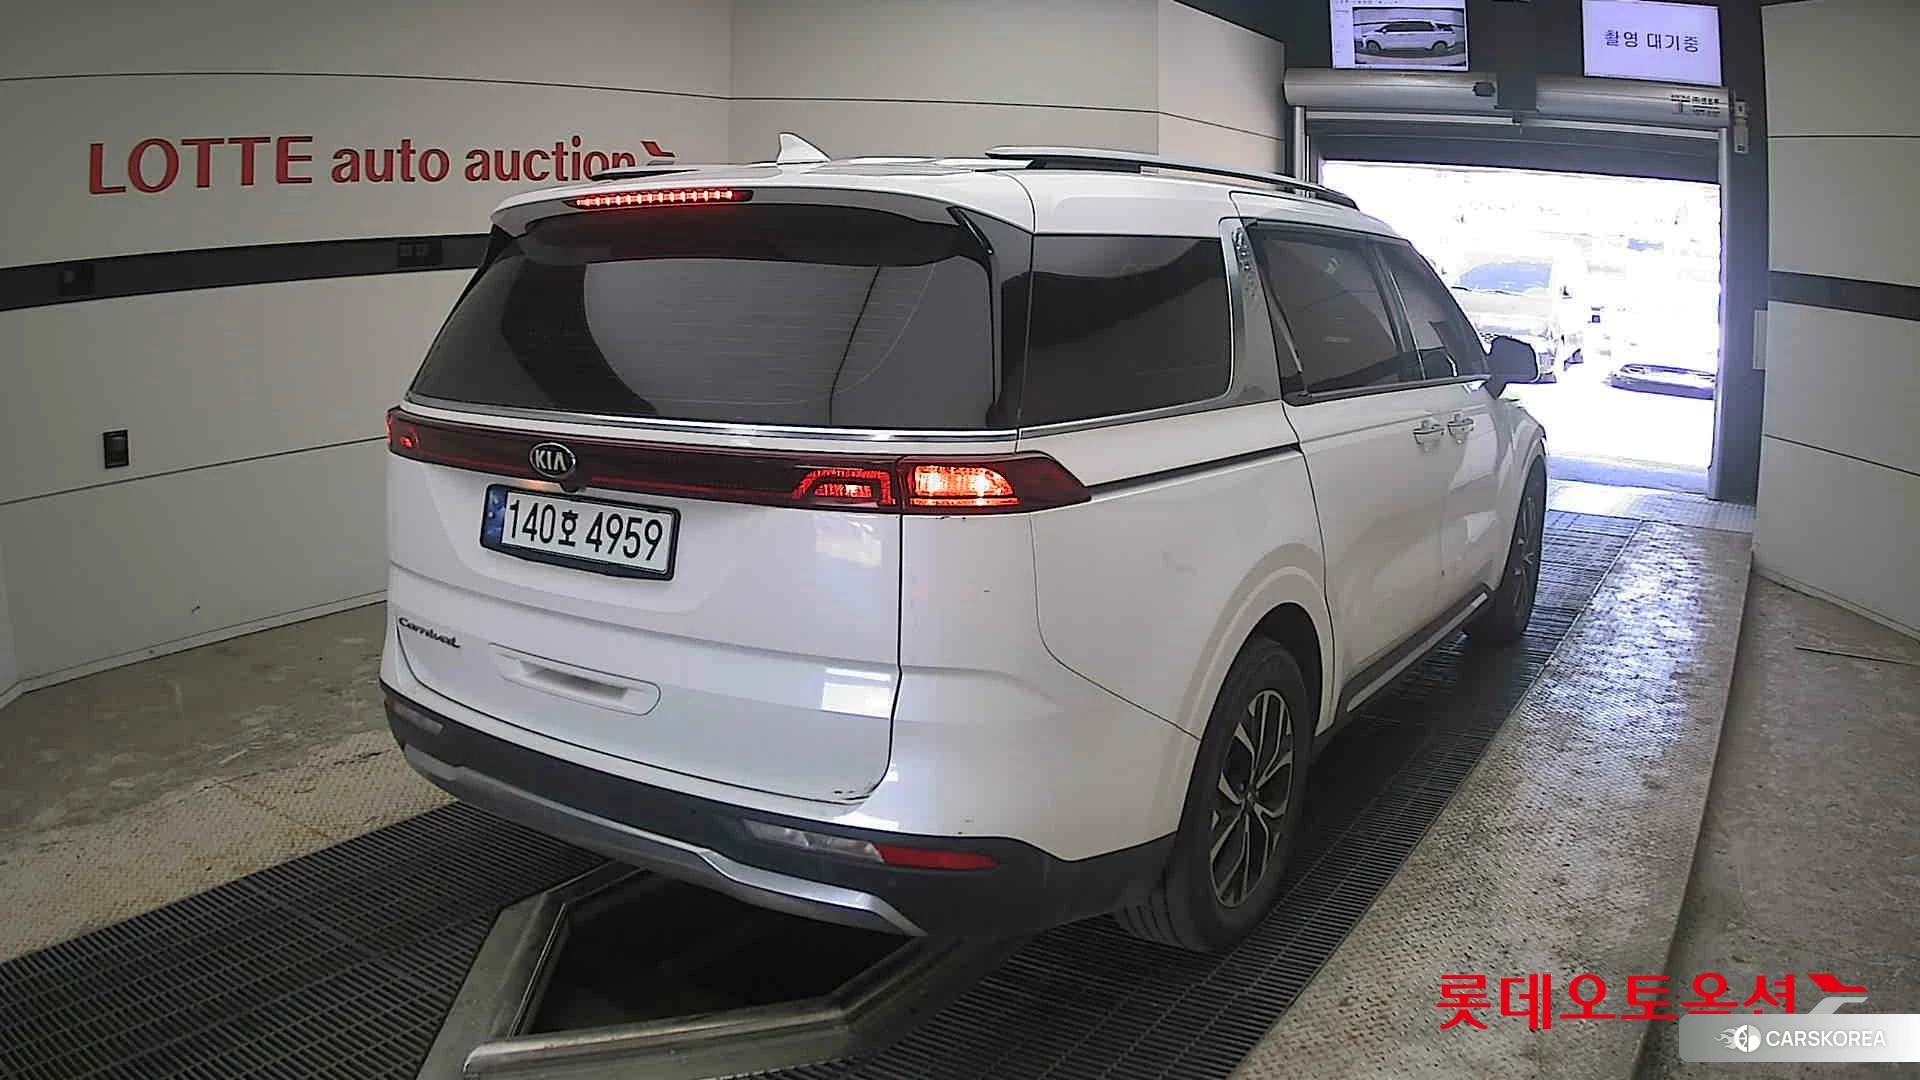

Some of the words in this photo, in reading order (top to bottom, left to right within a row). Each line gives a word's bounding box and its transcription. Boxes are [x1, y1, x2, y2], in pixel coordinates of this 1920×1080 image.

[1605, 29, 1638, 48] 촬영
[1646, 33, 1699, 53] 대기중
[88, 135, 313, 195] LOTTE
[331, 139, 451, 184] auto
[535, 449, 567, 471] KIA
[509, 499, 579, 548] 140호
[584, 510, 663, 561] 4959
[398, 617, 461, 649] Carnival
